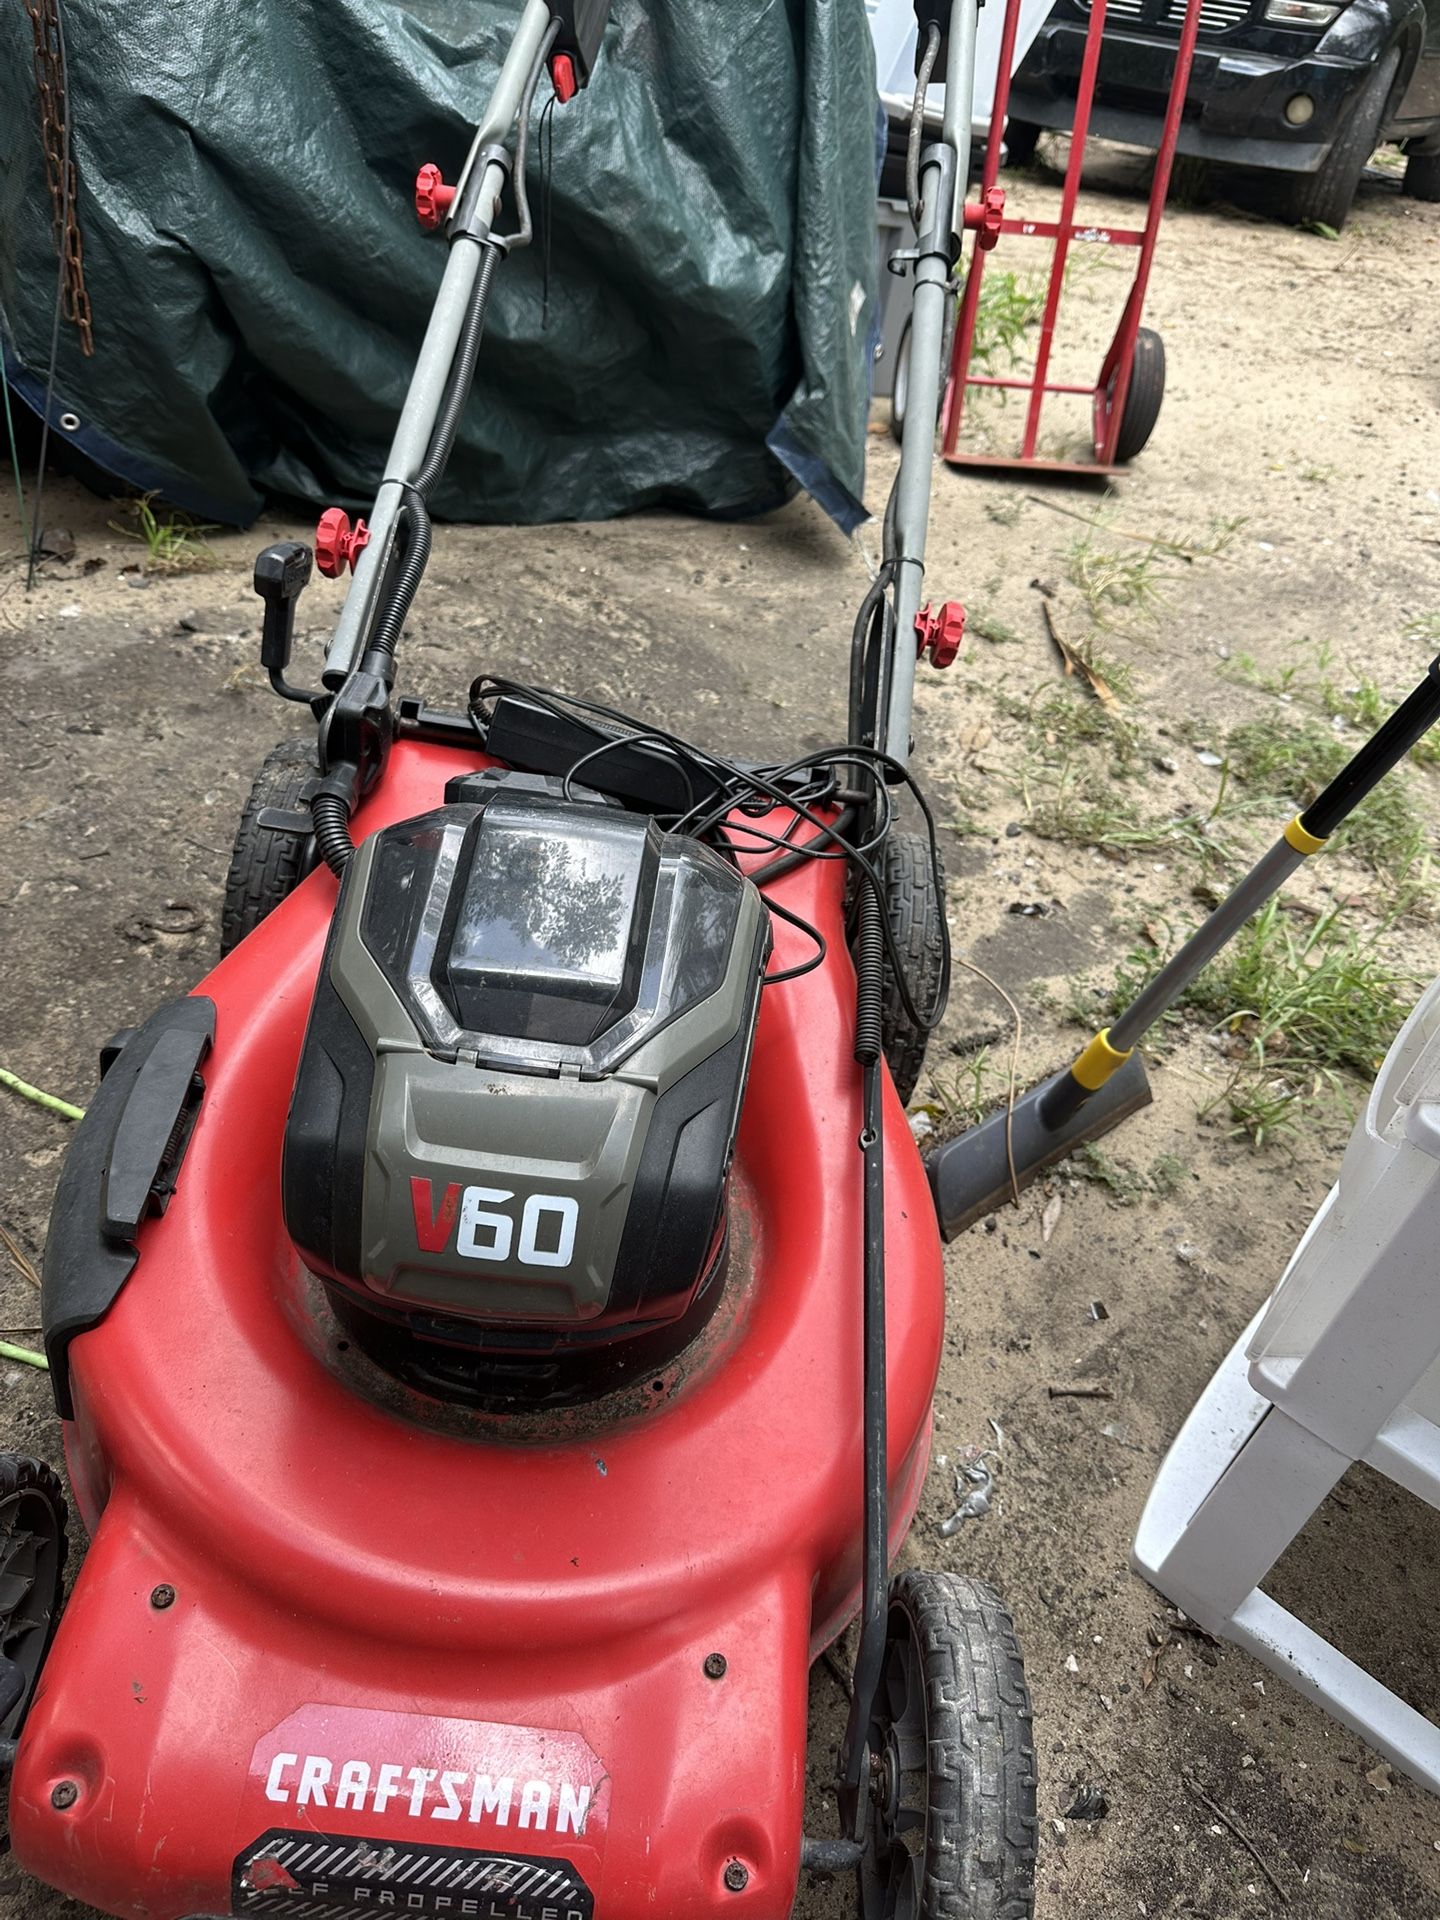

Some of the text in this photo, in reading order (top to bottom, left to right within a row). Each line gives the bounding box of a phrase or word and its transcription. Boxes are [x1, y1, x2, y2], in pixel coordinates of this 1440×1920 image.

[409, 1175, 579, 1268] V60
[265, 1752, 592, 1835] CRAFTSMAN
[353, 1886, 584, 1920] PROPELLED
